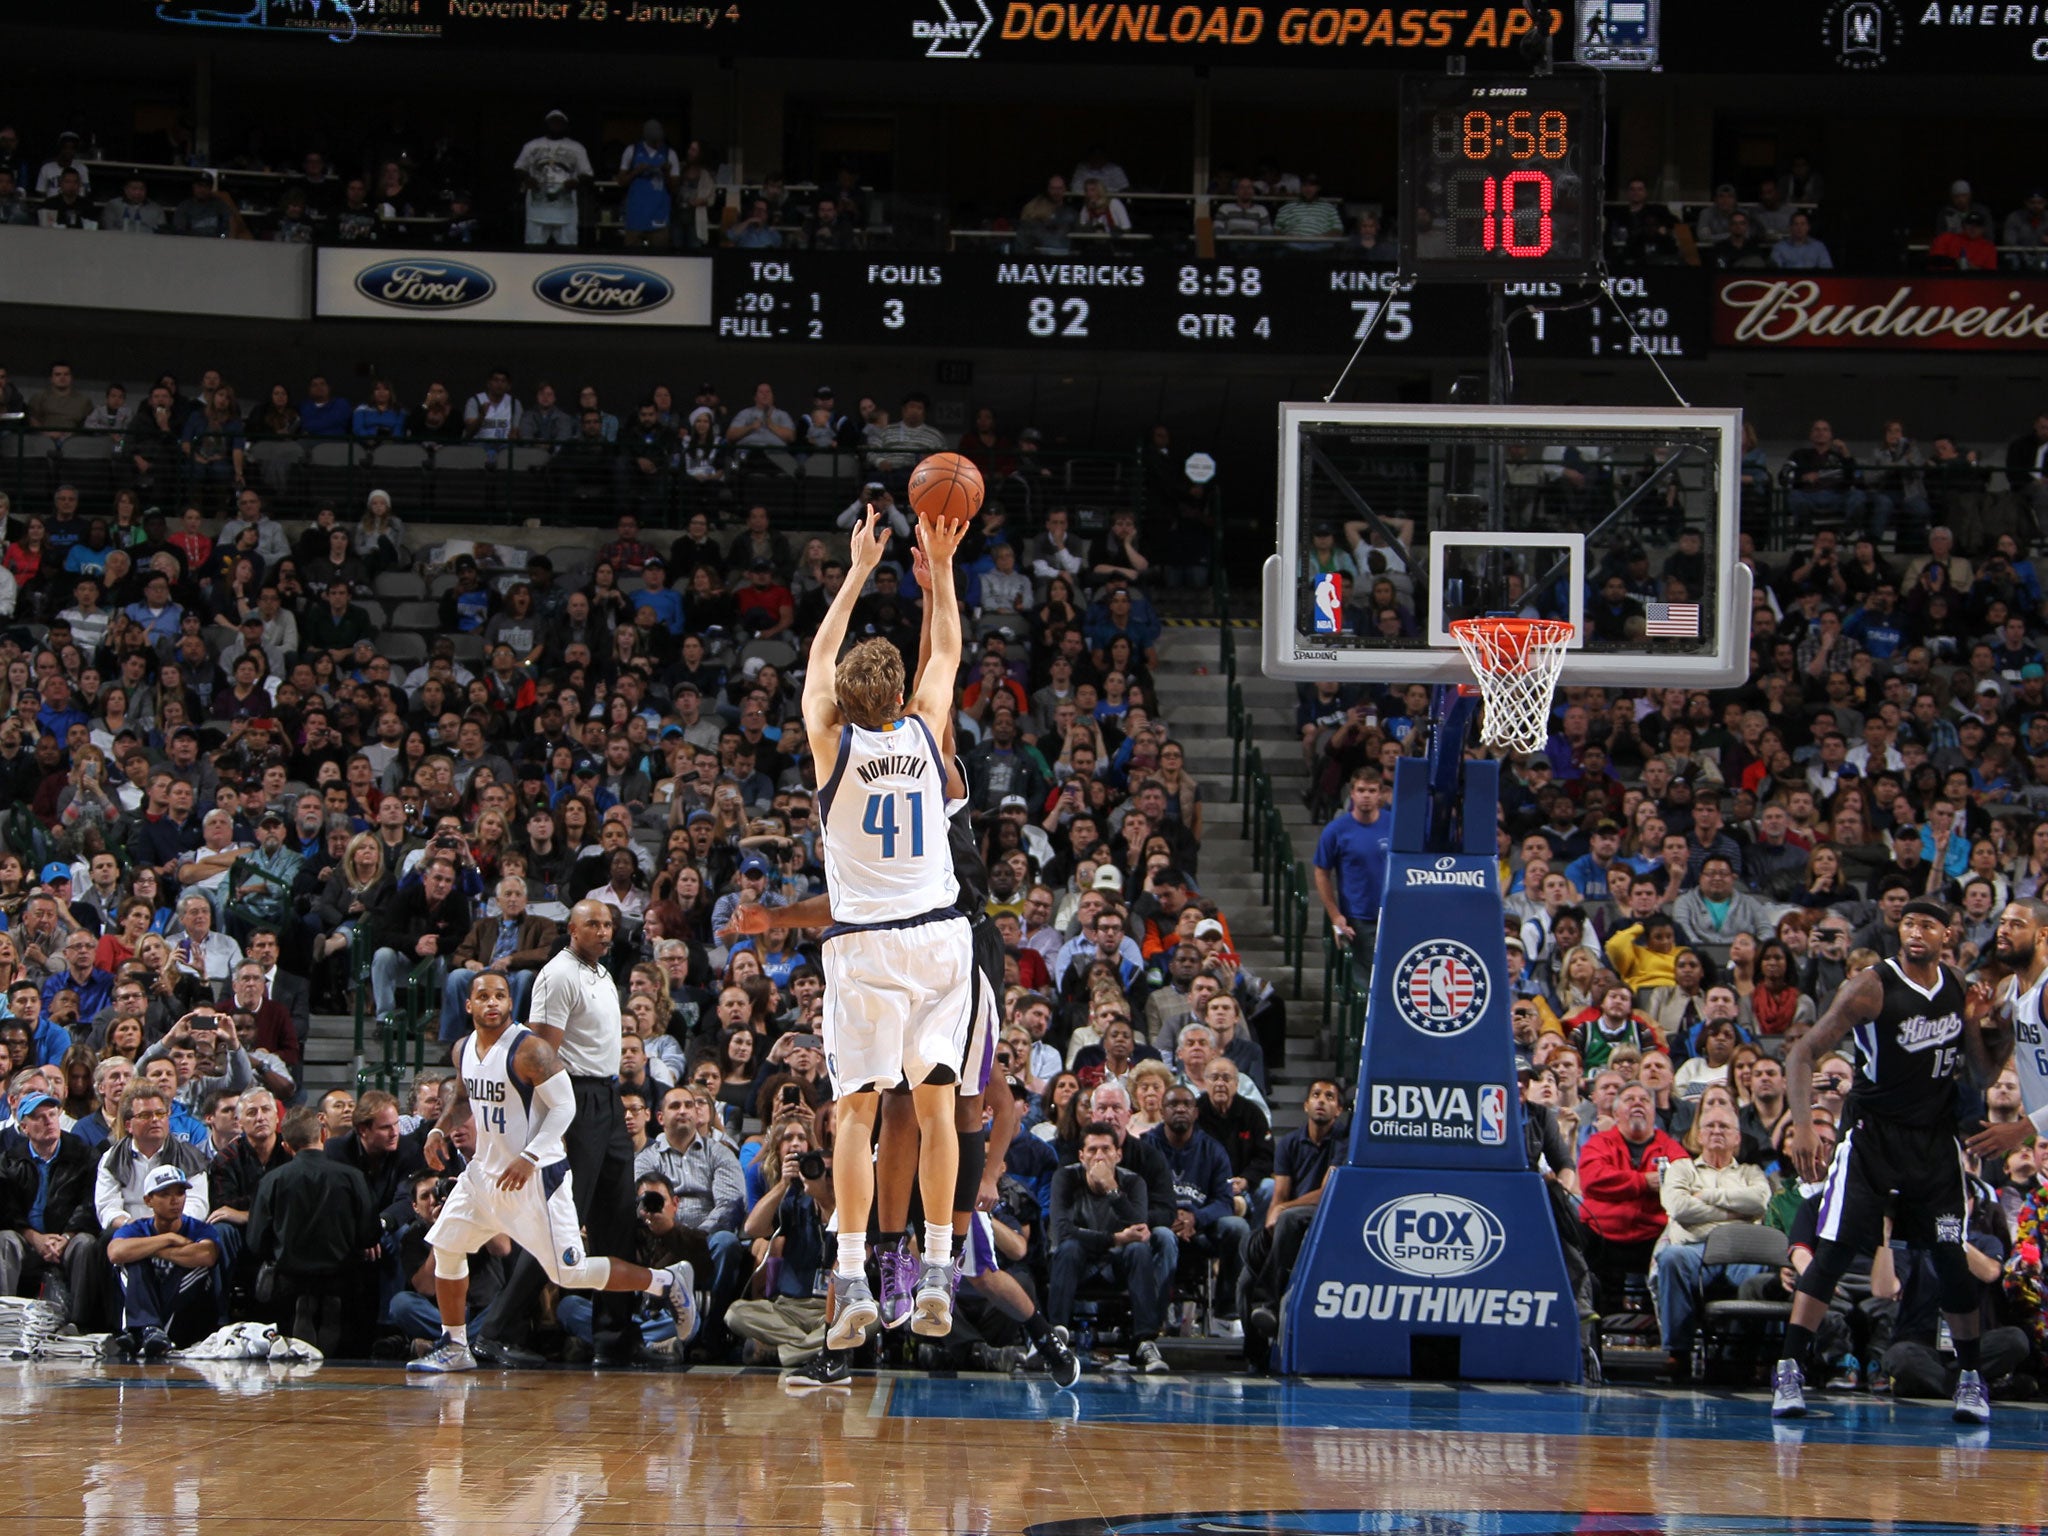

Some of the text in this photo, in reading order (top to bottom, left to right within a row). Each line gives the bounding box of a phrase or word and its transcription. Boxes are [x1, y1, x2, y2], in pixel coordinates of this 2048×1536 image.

[449, 0, 569, 19] November
[577, 1, 609, 21] 28
[625, 2, 719, 29] January
[723, 4, 741, 23] 4
[1001, 2, 1563, 48] DOWNLOAD GOPASS APP
[1919, 2, 2048, 25] AMERI
[912, 20, 978, 39] DART
[1472, 88, 1528, 96] TS SPORTS
[1463, 110, 1568, 160] 8:58
[1483, 170, 1553, 258] 10
[382, 265, 468, 300] Ford
[751, 261, 794, 282] TOL
[868, 265, 942, 285] FOULS
[997, 263, 1145, 287] MAVERICKS
[1178, 265, 1263, 297] 8:58
[560, 270, 646, 306] Ford
[1504, 282, 1562, 297] OULS
[1604, 276, 1648, 297] TOL
[736, 292, 774, 312] :20
[810, 292, 821, 312] 1
[883, 298, 905, 329] 3
[1720, 279, 2048, 342] Budweise
[719, 316, 772, 337] FULL
[808, 318, 823, 339] 2
[1027, 297, 1090, 338] 82
[1177, 313, 1271, 339] QTR 4
[1350, 300, 1413, 341] 75
[1531, 310, 1545, 341] 1
[1591, 307, 1600, 326] 1
[1632, 307, 1669, 327] :20
[1591, 335, 1600, 355] 1
[1630, 335, 1683, 356] FULL
[1294, 651, 1338, 661] SPALDING
[856, 755, 927, 783] NOWITZKI
[861, 790, 924, 859] 41
[1406, 869, 1485, 888] SPALDING
[1897, 1012, 1962, 1052] Kings
[1931, 1047, 1957, 1079] 15
[1371, 1085, 1474, 1121] BBVA
[482, 1106, 506, 1134] 14
[1370, 1120, 1474, 1139] Official Bank
[1395, 1210, 1474, 1246] FOX
[1394, 1246, 1475, 1261] SPORTS
[1314, 1281, 1558, 1327] SOUTHWEST
